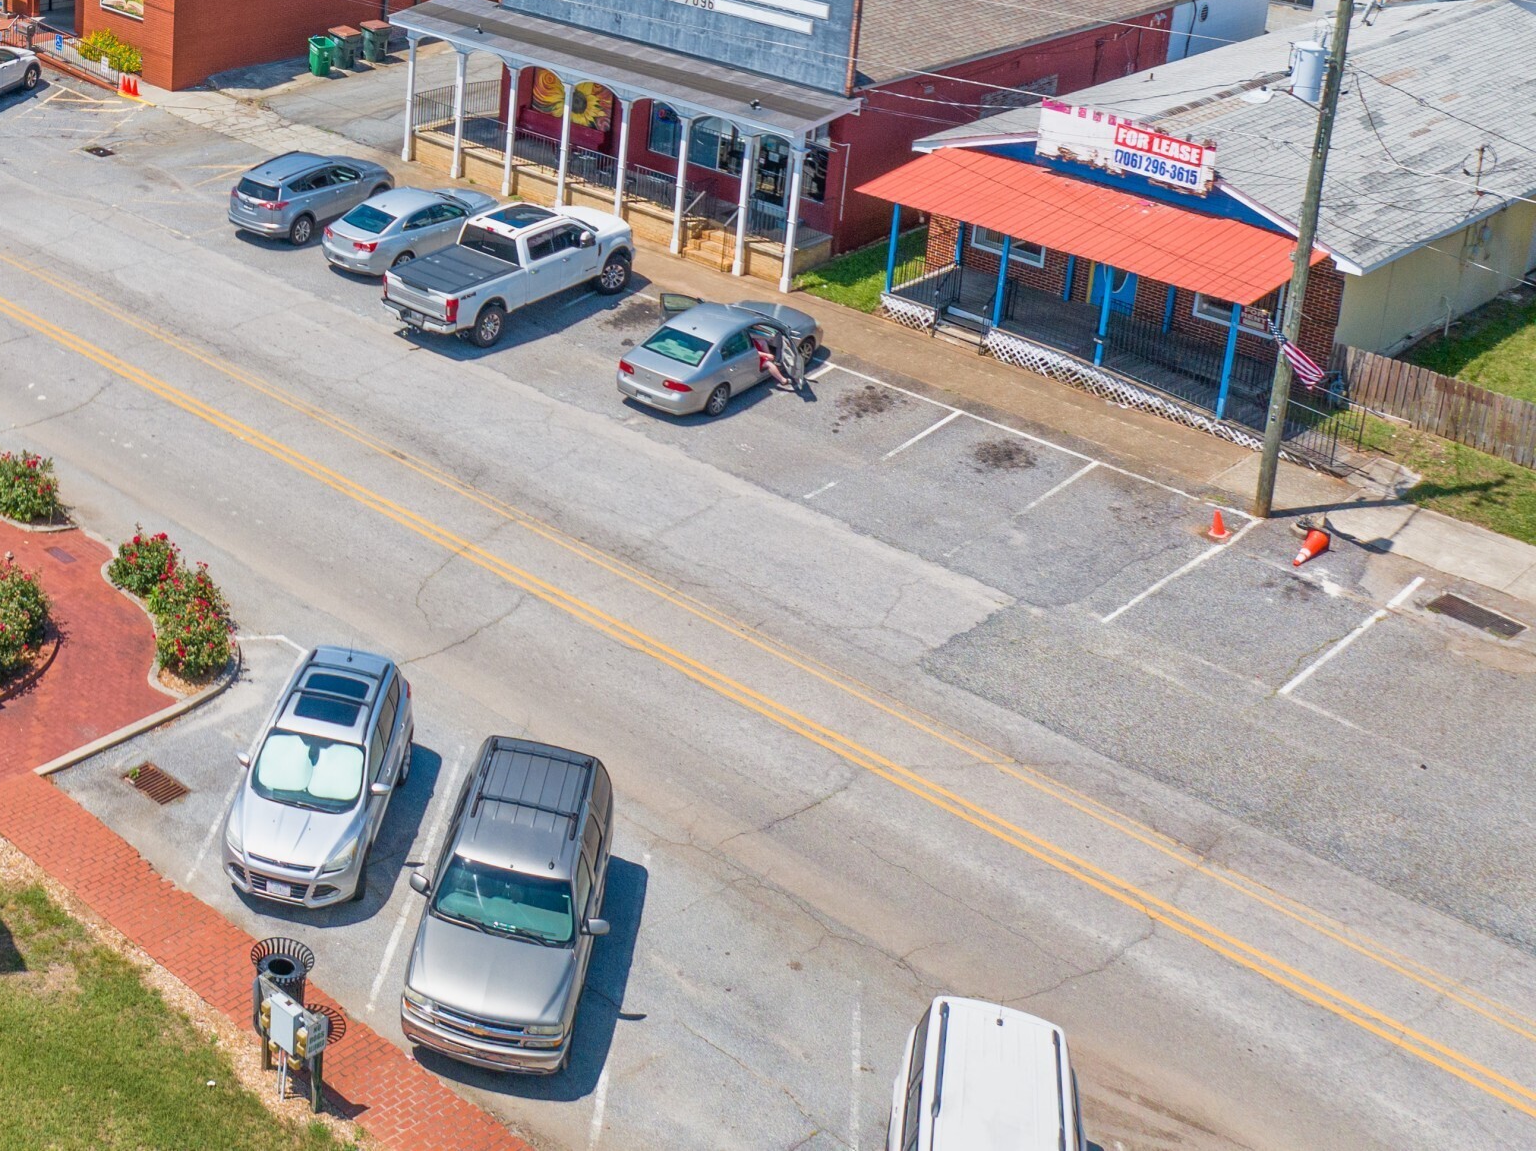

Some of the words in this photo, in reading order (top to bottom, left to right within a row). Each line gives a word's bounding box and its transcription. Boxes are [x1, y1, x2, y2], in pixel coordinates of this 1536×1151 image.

[1117, 127, 1150, 150] FOR
[1152, 136, 1201, 165] LEASE
[1114, 148, 1143, 170] (706)
[1144, 156, 1198, 185] 296-3615
[1241, 311, 1267, 323] RENT
